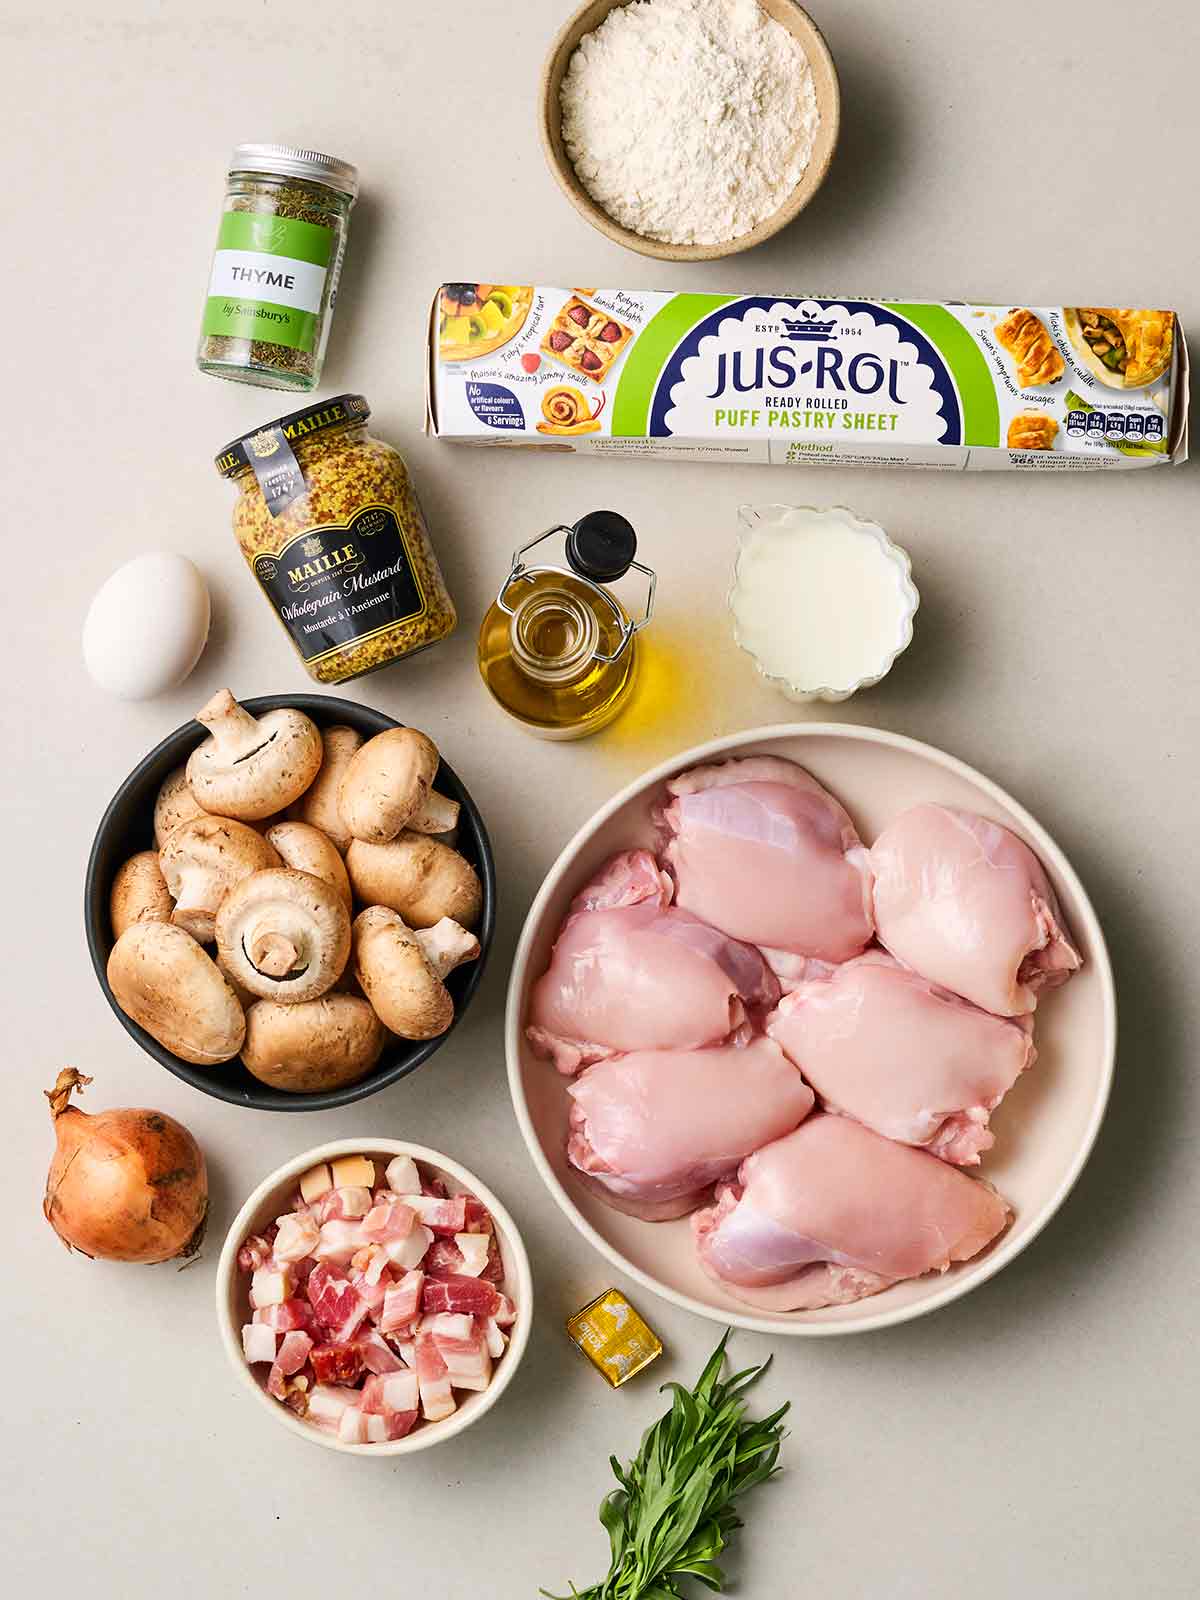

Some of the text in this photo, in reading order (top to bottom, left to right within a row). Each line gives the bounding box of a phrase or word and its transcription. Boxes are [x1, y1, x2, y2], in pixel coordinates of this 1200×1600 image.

[232, 267, 295, 290] THYME
[223, 303, 235, 317] by
[840, 327, 862, 336] 1954
[1056, 339, 1075, 367] chicken
[470, 368, 502, 380] Maisie's
[504, 373, 538, 385] amazing
[976, 329, 997, 356] Susan's
[994, 356, 1018, 396] sumptuous
[1020, 393, 1056, 406] sausages
[469, 384, 481, 396] No
[765, 396, 848, 410] READY ROLLED
[282, 406, 346, 440] MAILLE
[487, 415, 524, 427] 6 Servings
[715, 409, 899, 430] PUFF PASTRY SHEET
[790, 442, 833, 452] Method
[287, 543, 358, 585] MAILLE
[281, 555, 403, 620] Wholegrain Mustard
[303, 591, 391, 634] Moutarde à l'Ancienne
